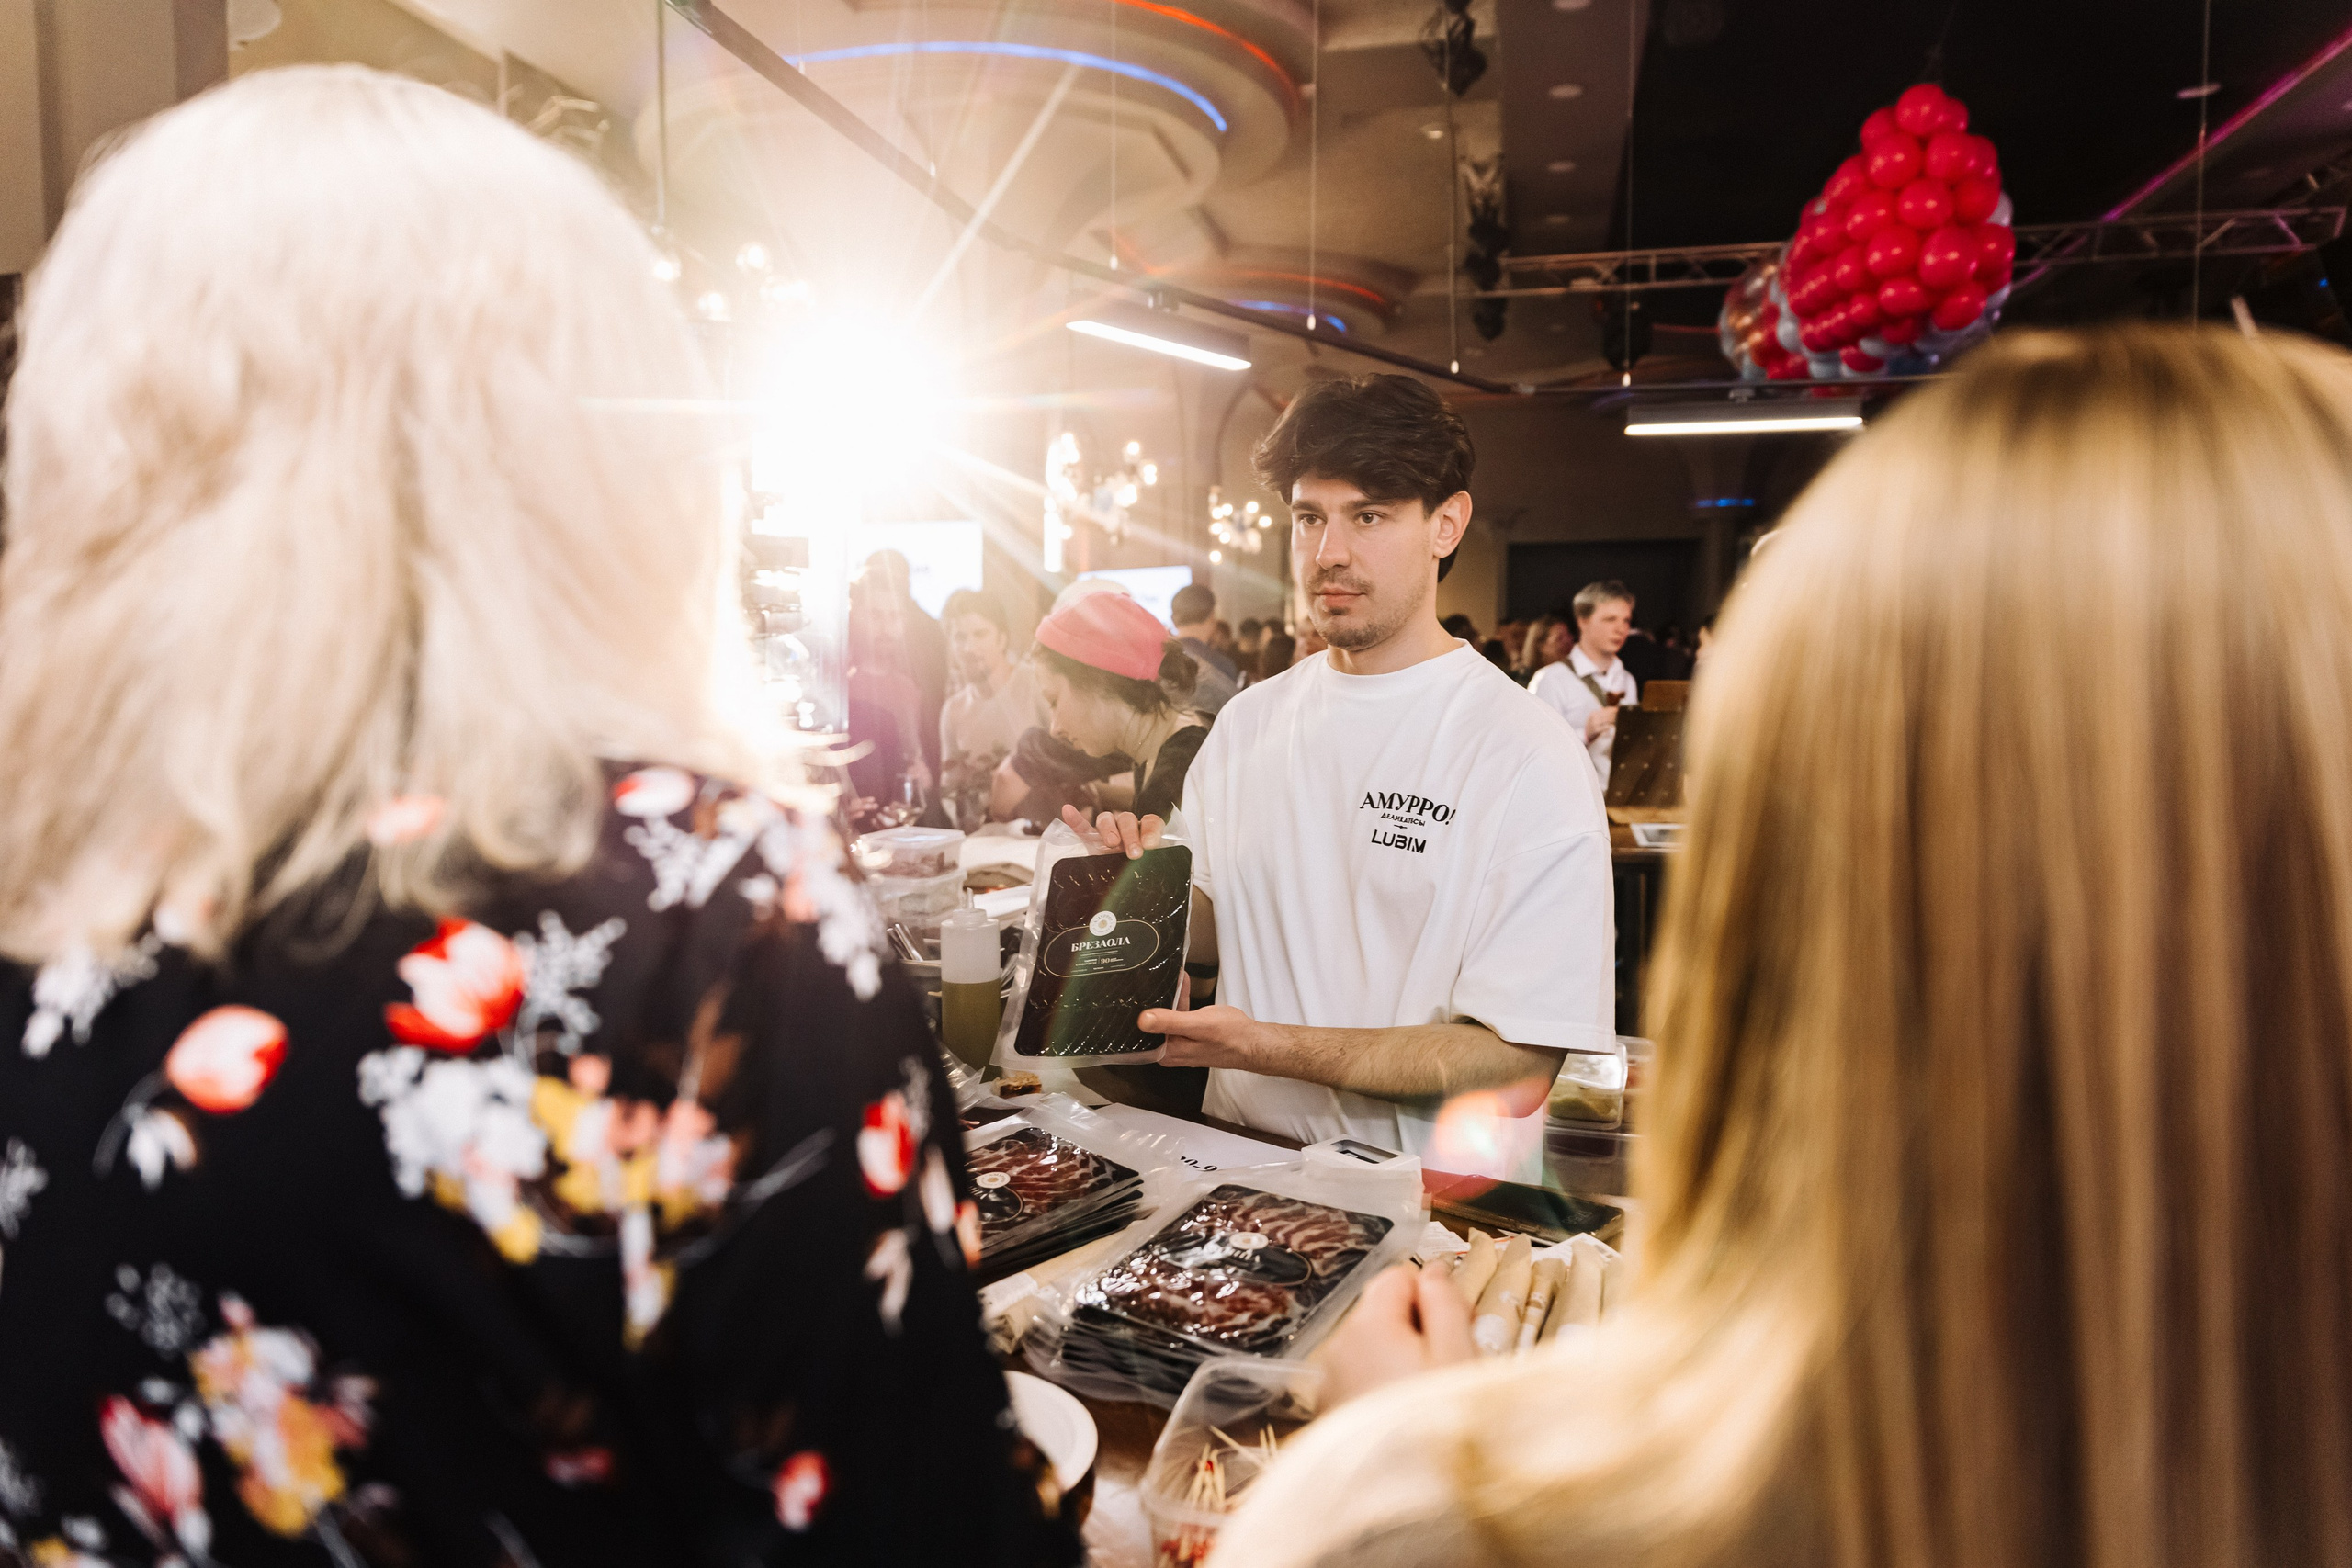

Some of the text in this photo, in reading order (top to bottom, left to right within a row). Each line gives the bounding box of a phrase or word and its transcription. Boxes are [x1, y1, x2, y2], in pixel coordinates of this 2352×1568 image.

[1359, 791, 1456, 825] АМУРРО!
[1371, 829, 1427, 853] LUBIM
[1070, 936, 1131, 953] БРЕЗАОЛА
